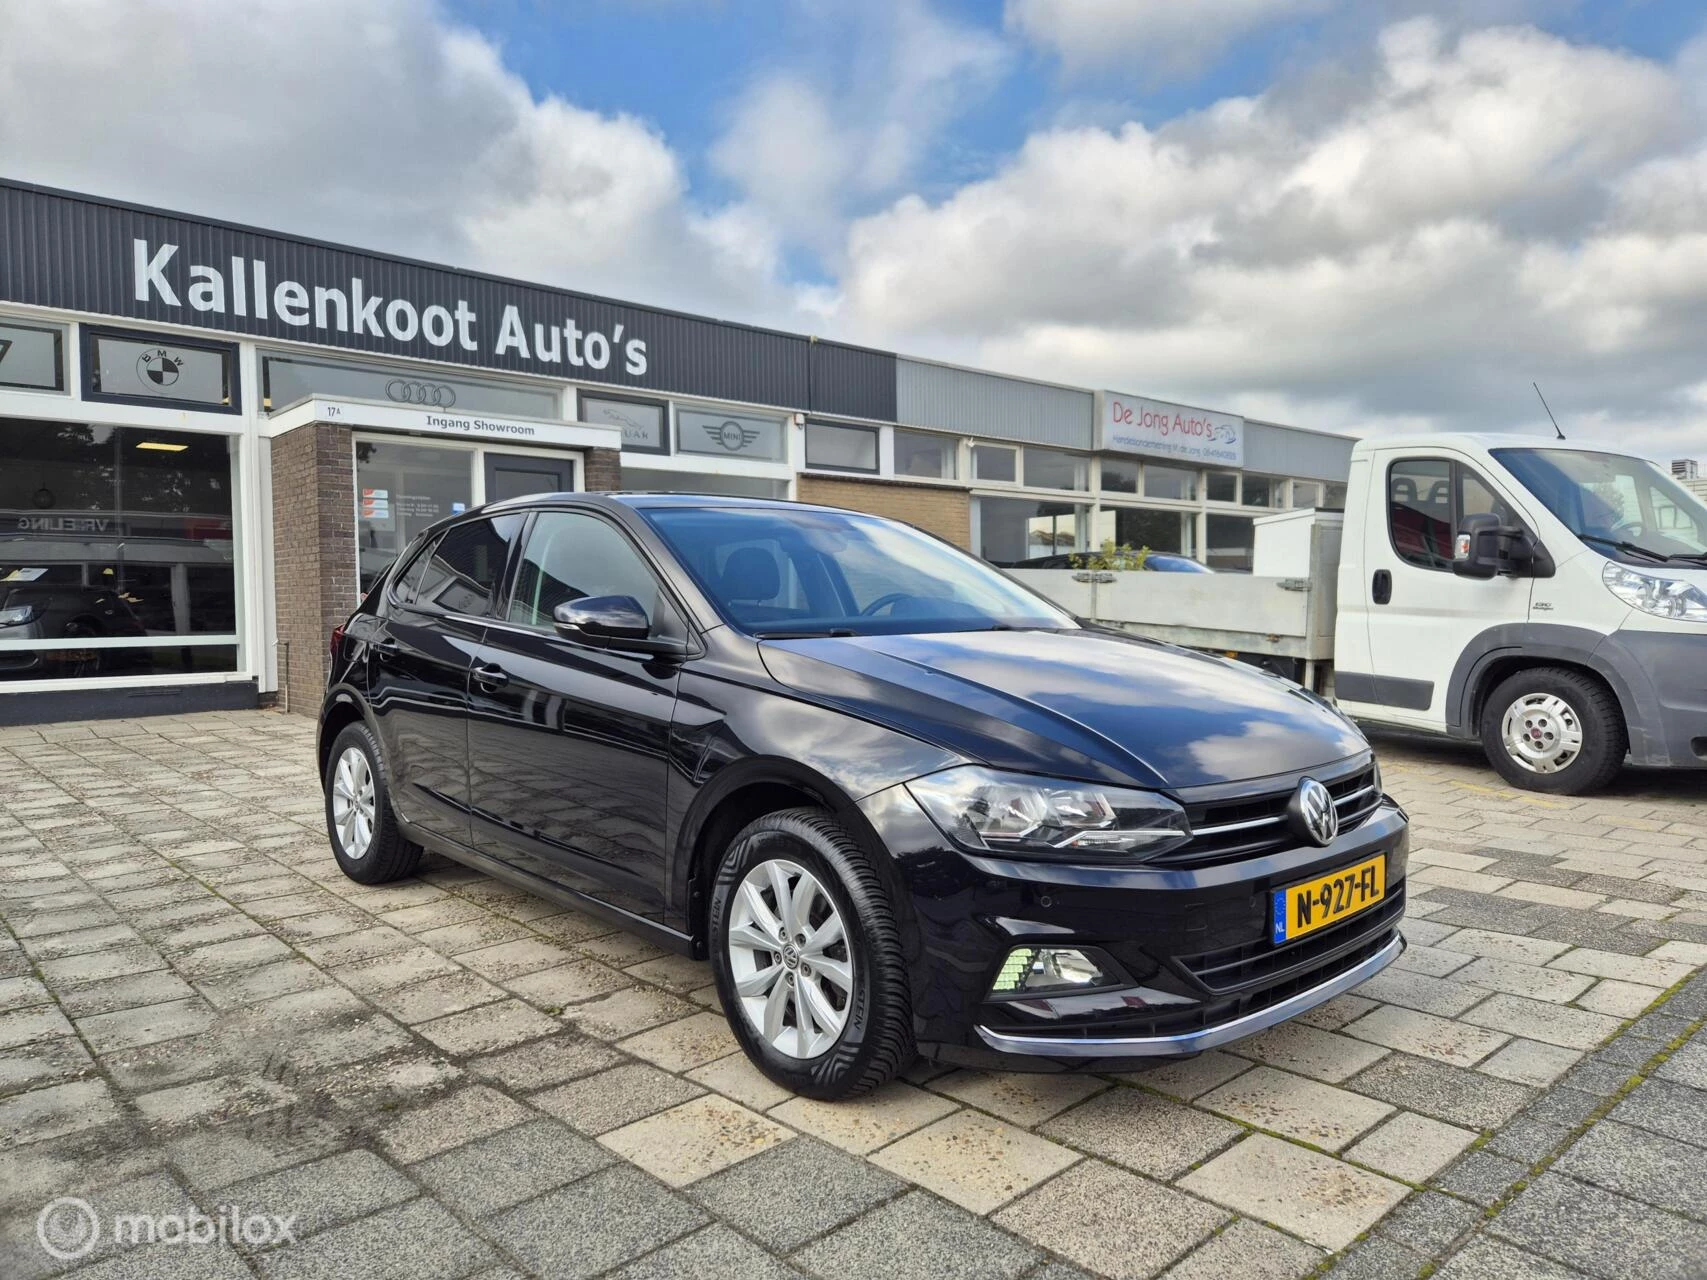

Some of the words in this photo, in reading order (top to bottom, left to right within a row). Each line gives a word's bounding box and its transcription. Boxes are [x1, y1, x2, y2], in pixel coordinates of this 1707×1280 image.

[133, 238, 478, 351] Kallenkoot
[495, 304, 648, 376] Auto's
[142, 350, 184, 367] BMW
[426, 415, 471, 431] Ingang
[474, 420, 535, 435] Showroom
[1112, 401, 1133, 425] De
[1137, 405, 1169, 437] Jong
[1172, 413, 1213, 438] Auto's
[624, 429, 649, 440] UAR
[723, 432, 742, 442] MINI
[1297, 865, 1379, 929] N-927-FL
[1275, 922, 1285, 935] NL
